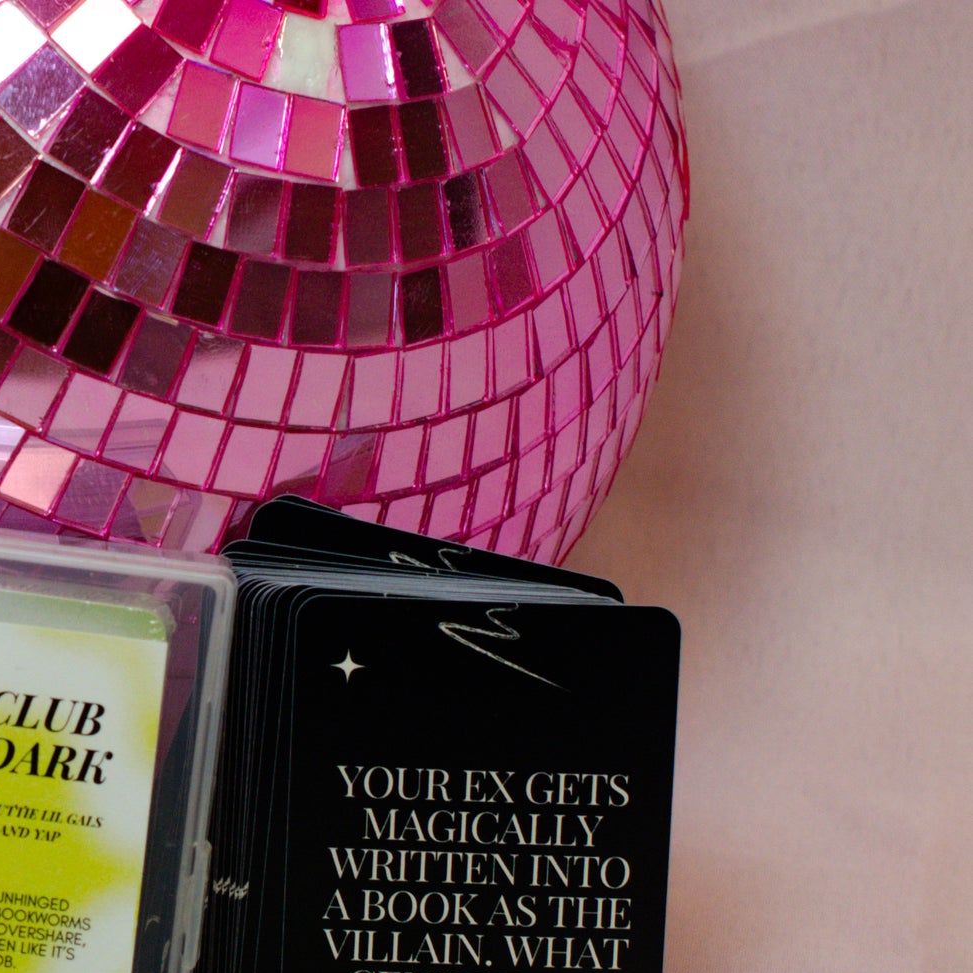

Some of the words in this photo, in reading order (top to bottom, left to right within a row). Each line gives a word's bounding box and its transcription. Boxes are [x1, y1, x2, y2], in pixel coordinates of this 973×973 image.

[336, 764, 453, 802] YOUR
[463, 769, 516, 804] EX
[525, 771, 631, 807] GETS
[34, 828, 61, 842] YAP
[41, 810, 63, 823] LIL
[67, 813, 104, 828] GALS
[362, 807, 604, 847] MAGICALLY
[328, 847, 519, 886] WRITTEN
[529, 854, 631, 890] INTO
[322, 888, 351, 920] A
[361, 889, 479, 925] BOOK
[487, 894, 537, 928] AS
[547, 896, 632, 930] THE
[20, 943, 47, 957] LIKE
[51, 946, 75, 960] IT'S
[323, 928, 493, 967] VILLAIN.
[503, 935, 630, 971] WHAT
